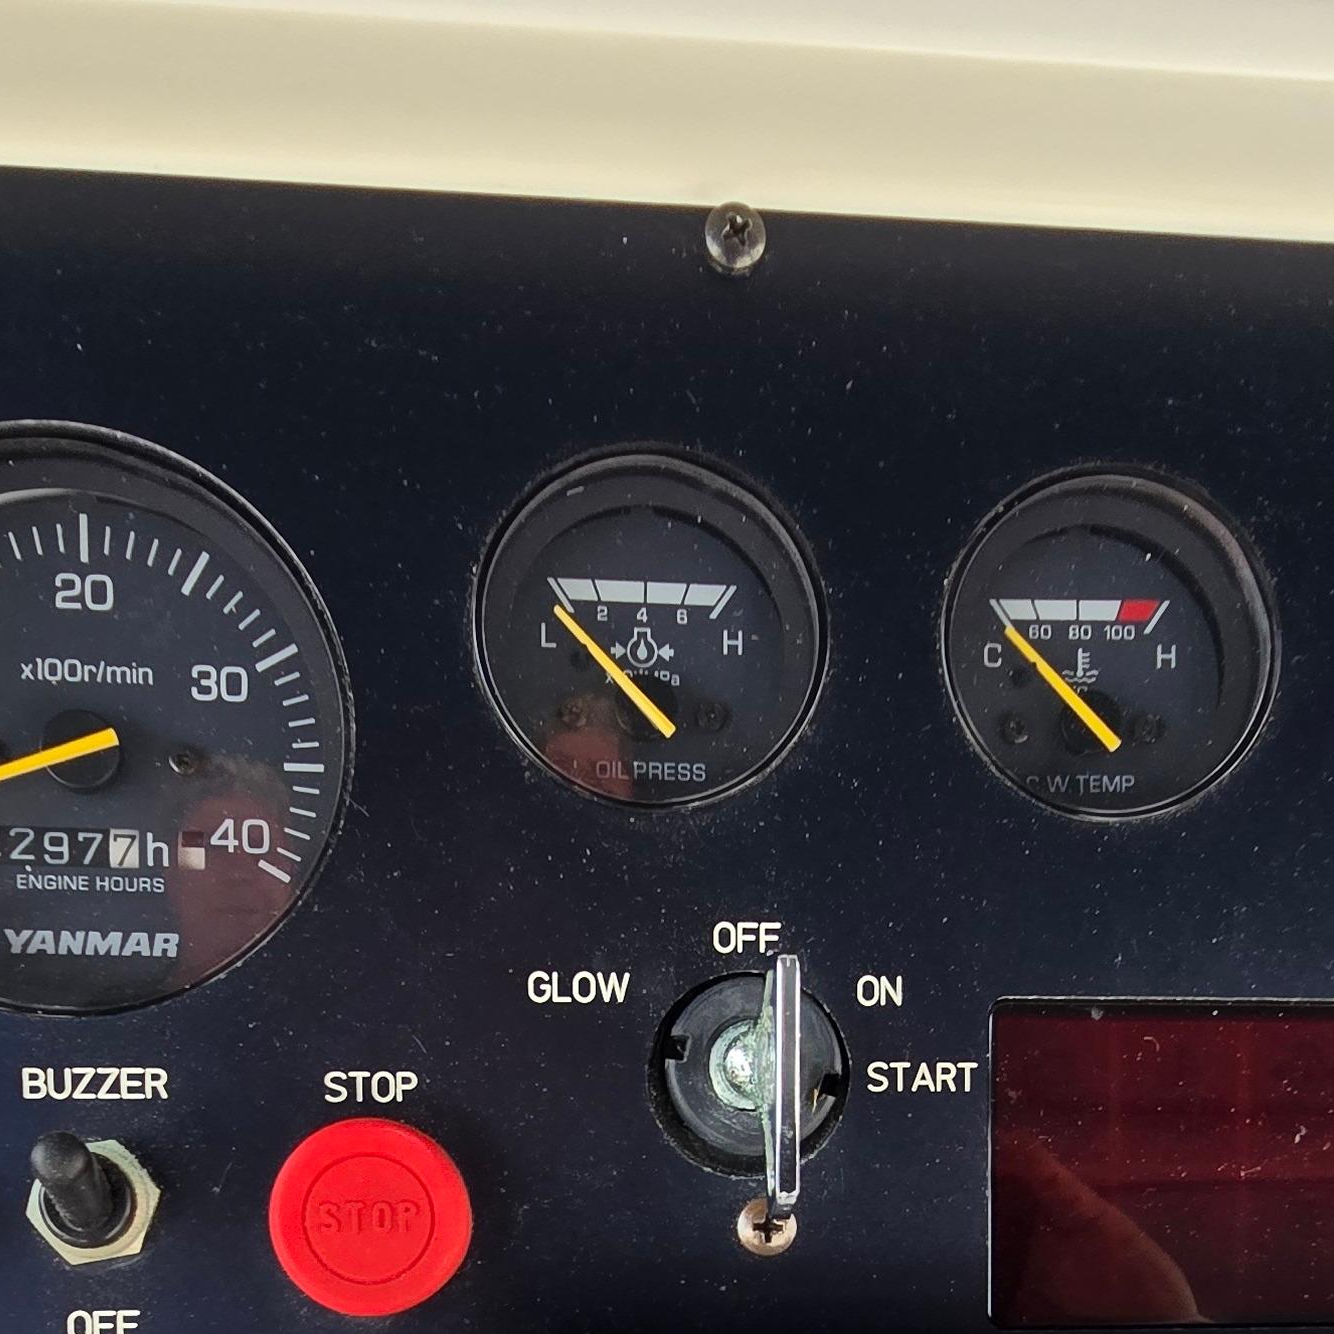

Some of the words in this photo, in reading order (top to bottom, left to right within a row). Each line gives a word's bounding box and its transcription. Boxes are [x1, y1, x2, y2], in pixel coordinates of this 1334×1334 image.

[55, 573, 114, 611] 20
[597, 605, 608, 621] 2
[636, 607, 648, 623] 4
[540, 622, 557, 648] L
[723, 630, 743, 656] H
[1028, 624, 1052, 640] 60
[1068, 624, 1092, 640] 80
[1104, 624, 1135, 640] 100
[983, 642, 1002, 668] C
[1156, 644, 1176, 669] H
[191, 665, 248, 703] 30
[596, 762, 629, 779] OIL
[633, 762, 707, 781] PRESS
[210, 818, 270, 854] 40
[17, 874, 89, 891] ENGINE
[96, 876, 165, 893] HOURS
[4, 928, 180, 958] YANMAR
[712, 921, 781, 955] OFF
[527, 971, 630, 1004] GLOW
[857, 975, 903, 1007] ON
[22, 1067, 168, 1100] BUZZER
[323, 1071, 419, 1103] STOP
[867, 1061, 978, 1093] START
[319, 1201, 420, 1234] STOP
